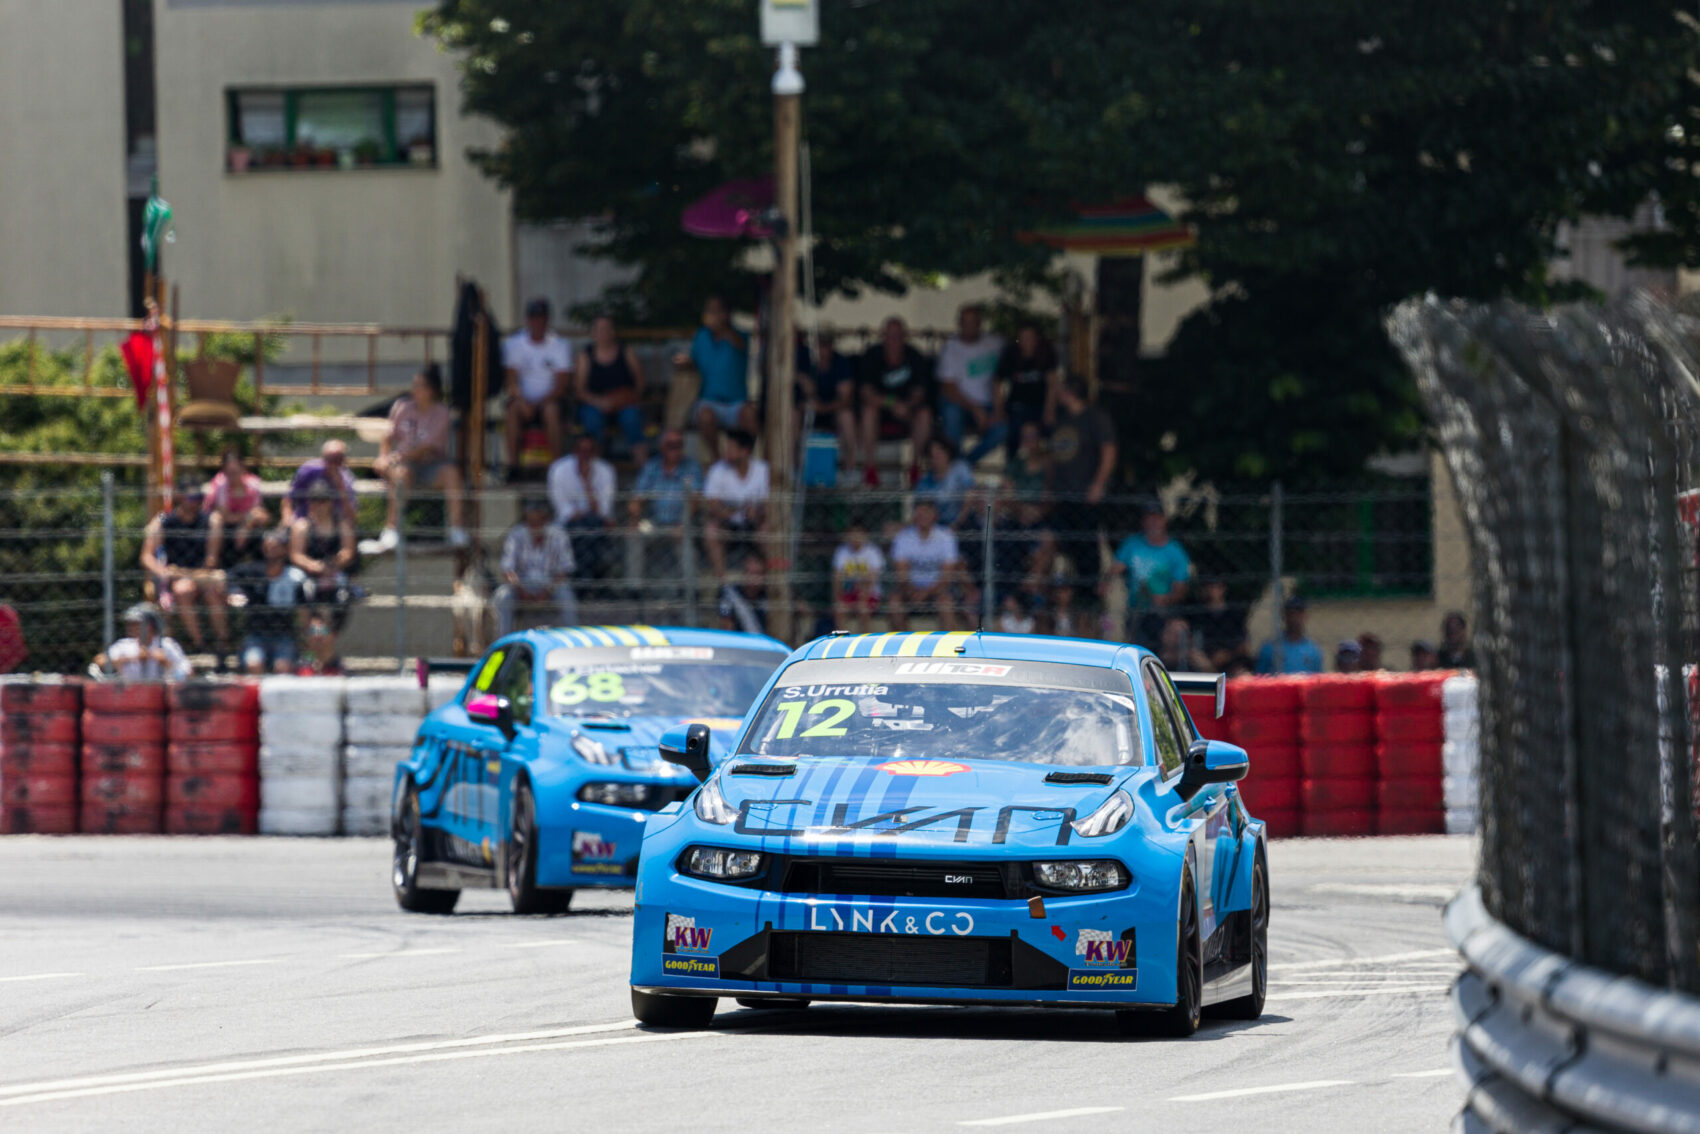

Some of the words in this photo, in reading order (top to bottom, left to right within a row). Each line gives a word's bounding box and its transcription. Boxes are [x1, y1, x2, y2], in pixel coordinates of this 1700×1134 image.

[550, 672, 626, 705] 68
[776, 698, 856, 739] 12
[675, 926, 713, 950] KW
[1085, 939, 1132, 963] KW
[665, 959, 716, 973] GOODYEAR
[1072, 972, 1134, 987] GOODYEAR
